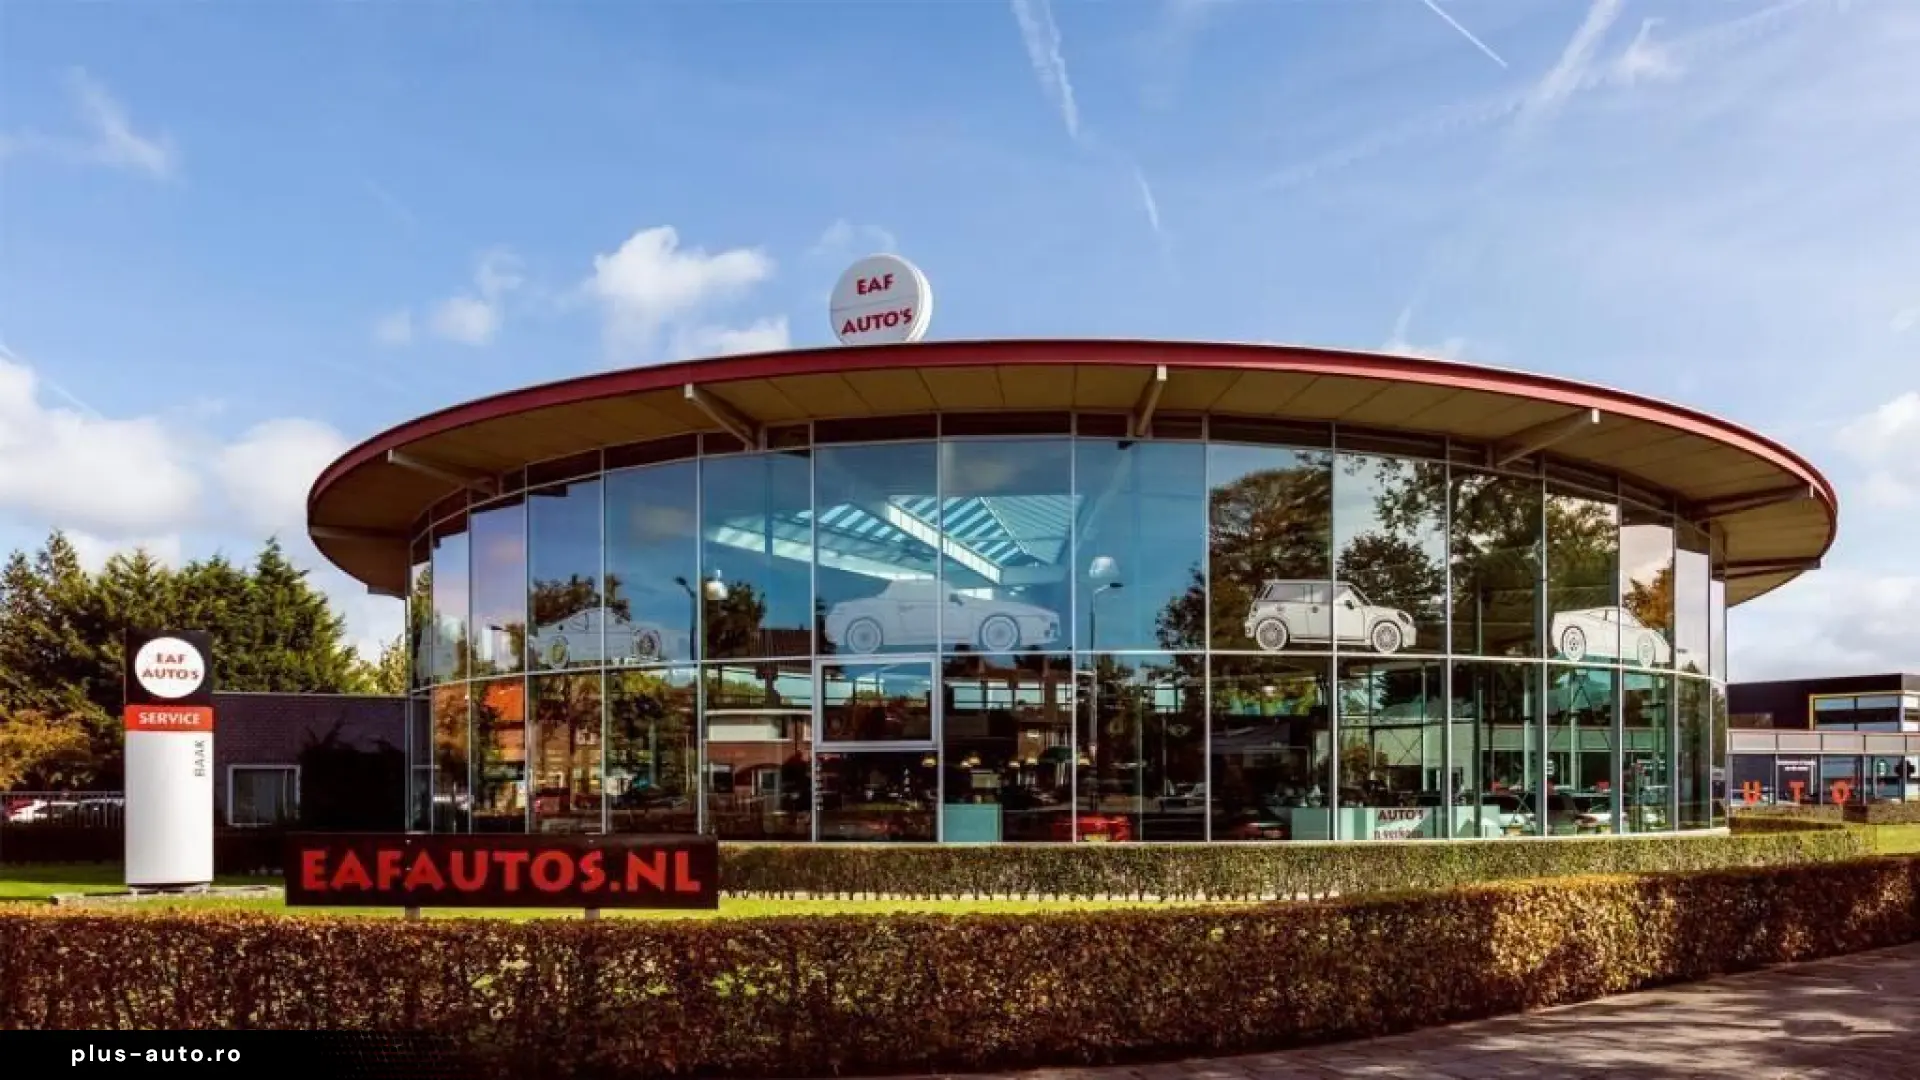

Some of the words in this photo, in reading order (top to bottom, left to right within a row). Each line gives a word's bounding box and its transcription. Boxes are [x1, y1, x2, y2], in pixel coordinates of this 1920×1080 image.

[857, 273, 893, 295] EAF
[841, 307, 912, 335] AUTO'S
[156, 653, 187, 664] EAF
[138, 711, 200, 725] SERVICE
[302, 849, 701, 892] EAFAUTOS.NL
